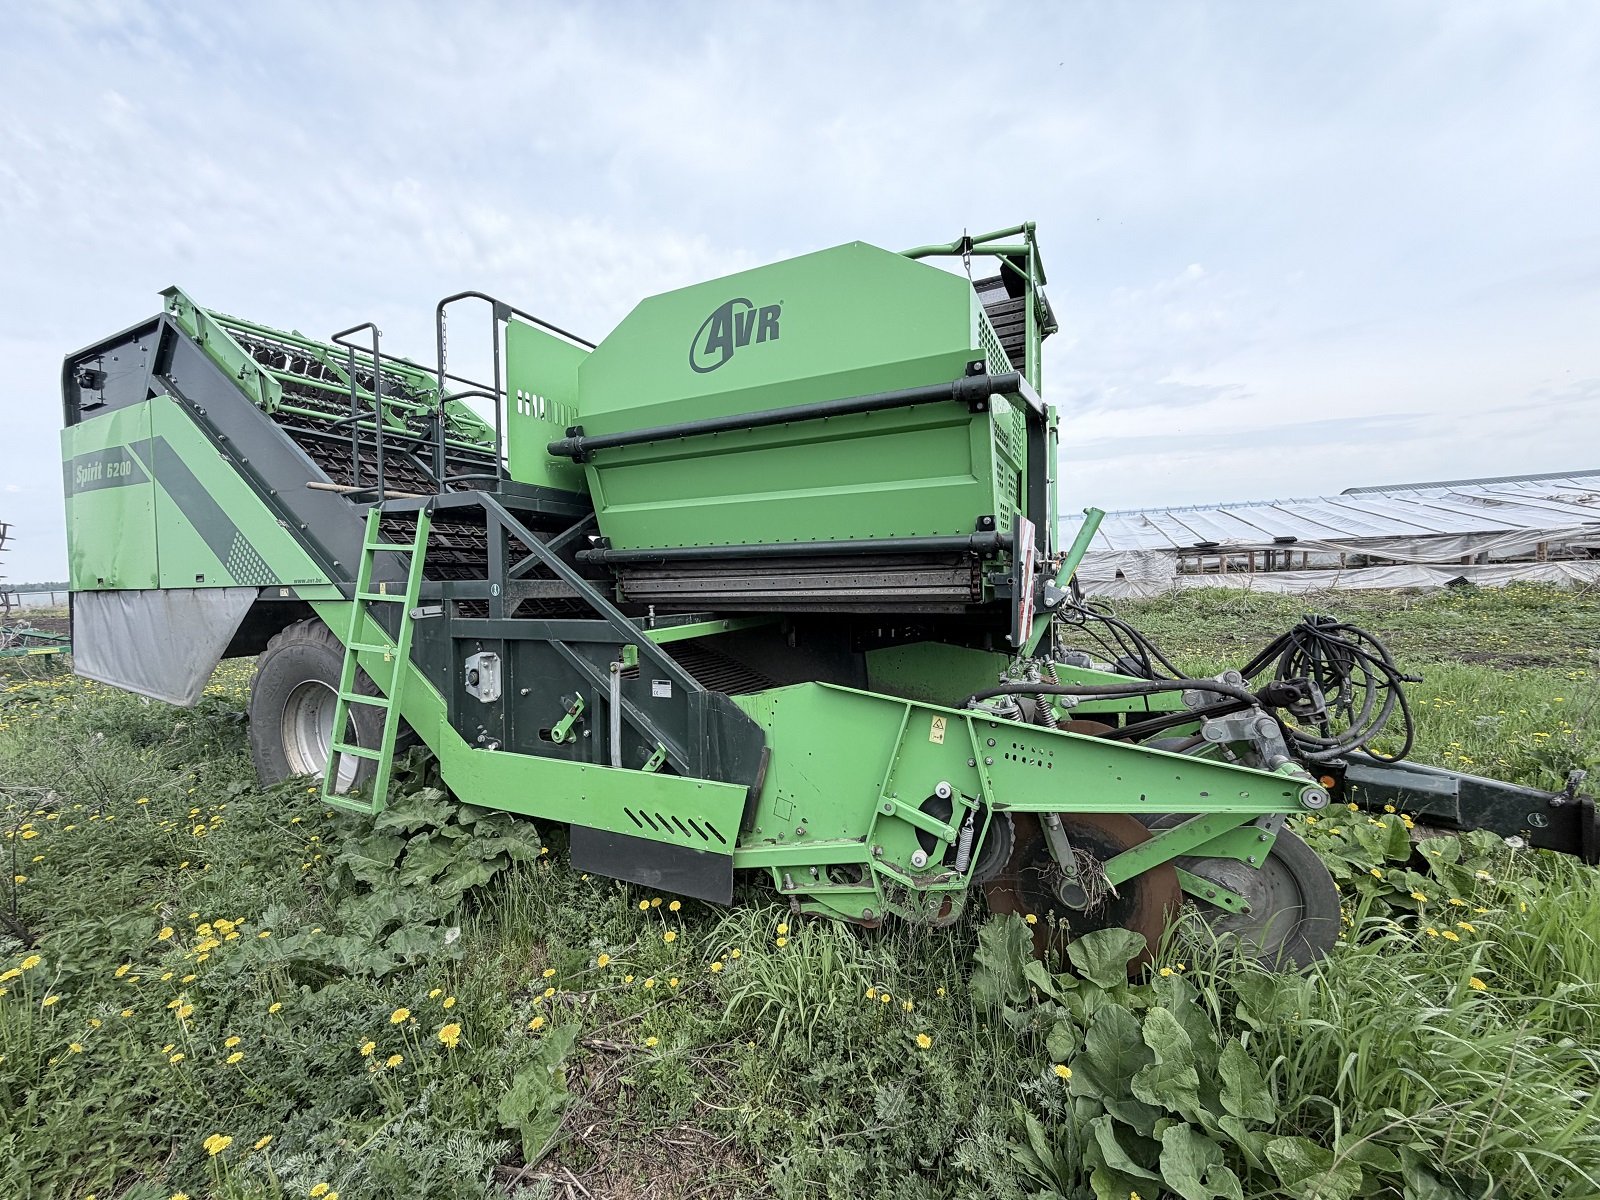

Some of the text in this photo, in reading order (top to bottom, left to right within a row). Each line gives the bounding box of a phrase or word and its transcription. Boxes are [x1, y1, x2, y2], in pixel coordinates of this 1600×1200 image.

[689, 297, 782, 374] AVR
[76, 460, 131, 487] Spirit 6200
